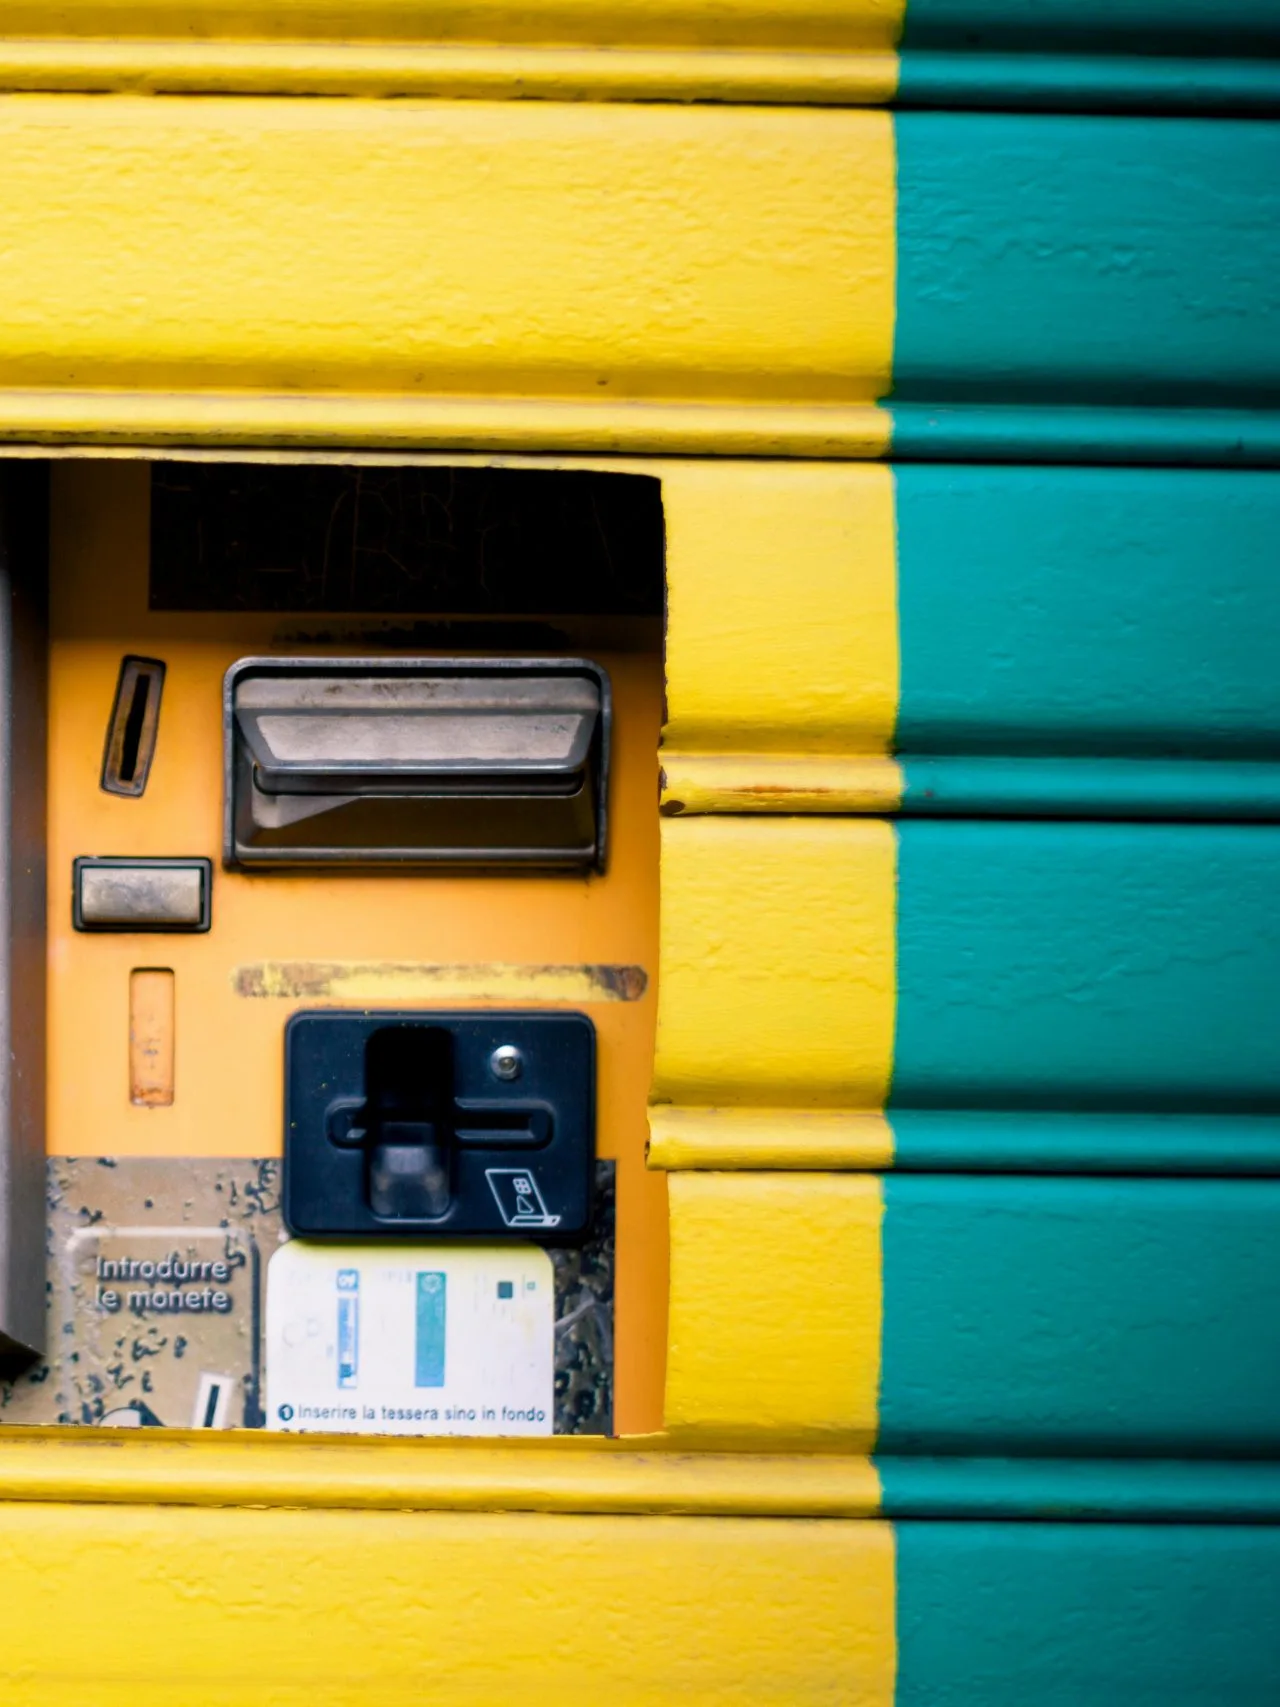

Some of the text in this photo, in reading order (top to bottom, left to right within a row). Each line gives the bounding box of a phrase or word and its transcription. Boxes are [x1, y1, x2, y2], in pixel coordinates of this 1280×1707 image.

[96, 1252, 228, 1280] Introdurre
[95, 1284, 229, 1310] le monete
[299, 1404, 357, 1420] Inserire
[363, 1405, 376, 1420] la
[381, 1406, 439, 1421] tessera
[445, 1405, 476, 1421] sino
[482, 1406, 496, 1421] in
[502, 1406, 546, 1422] fondo
